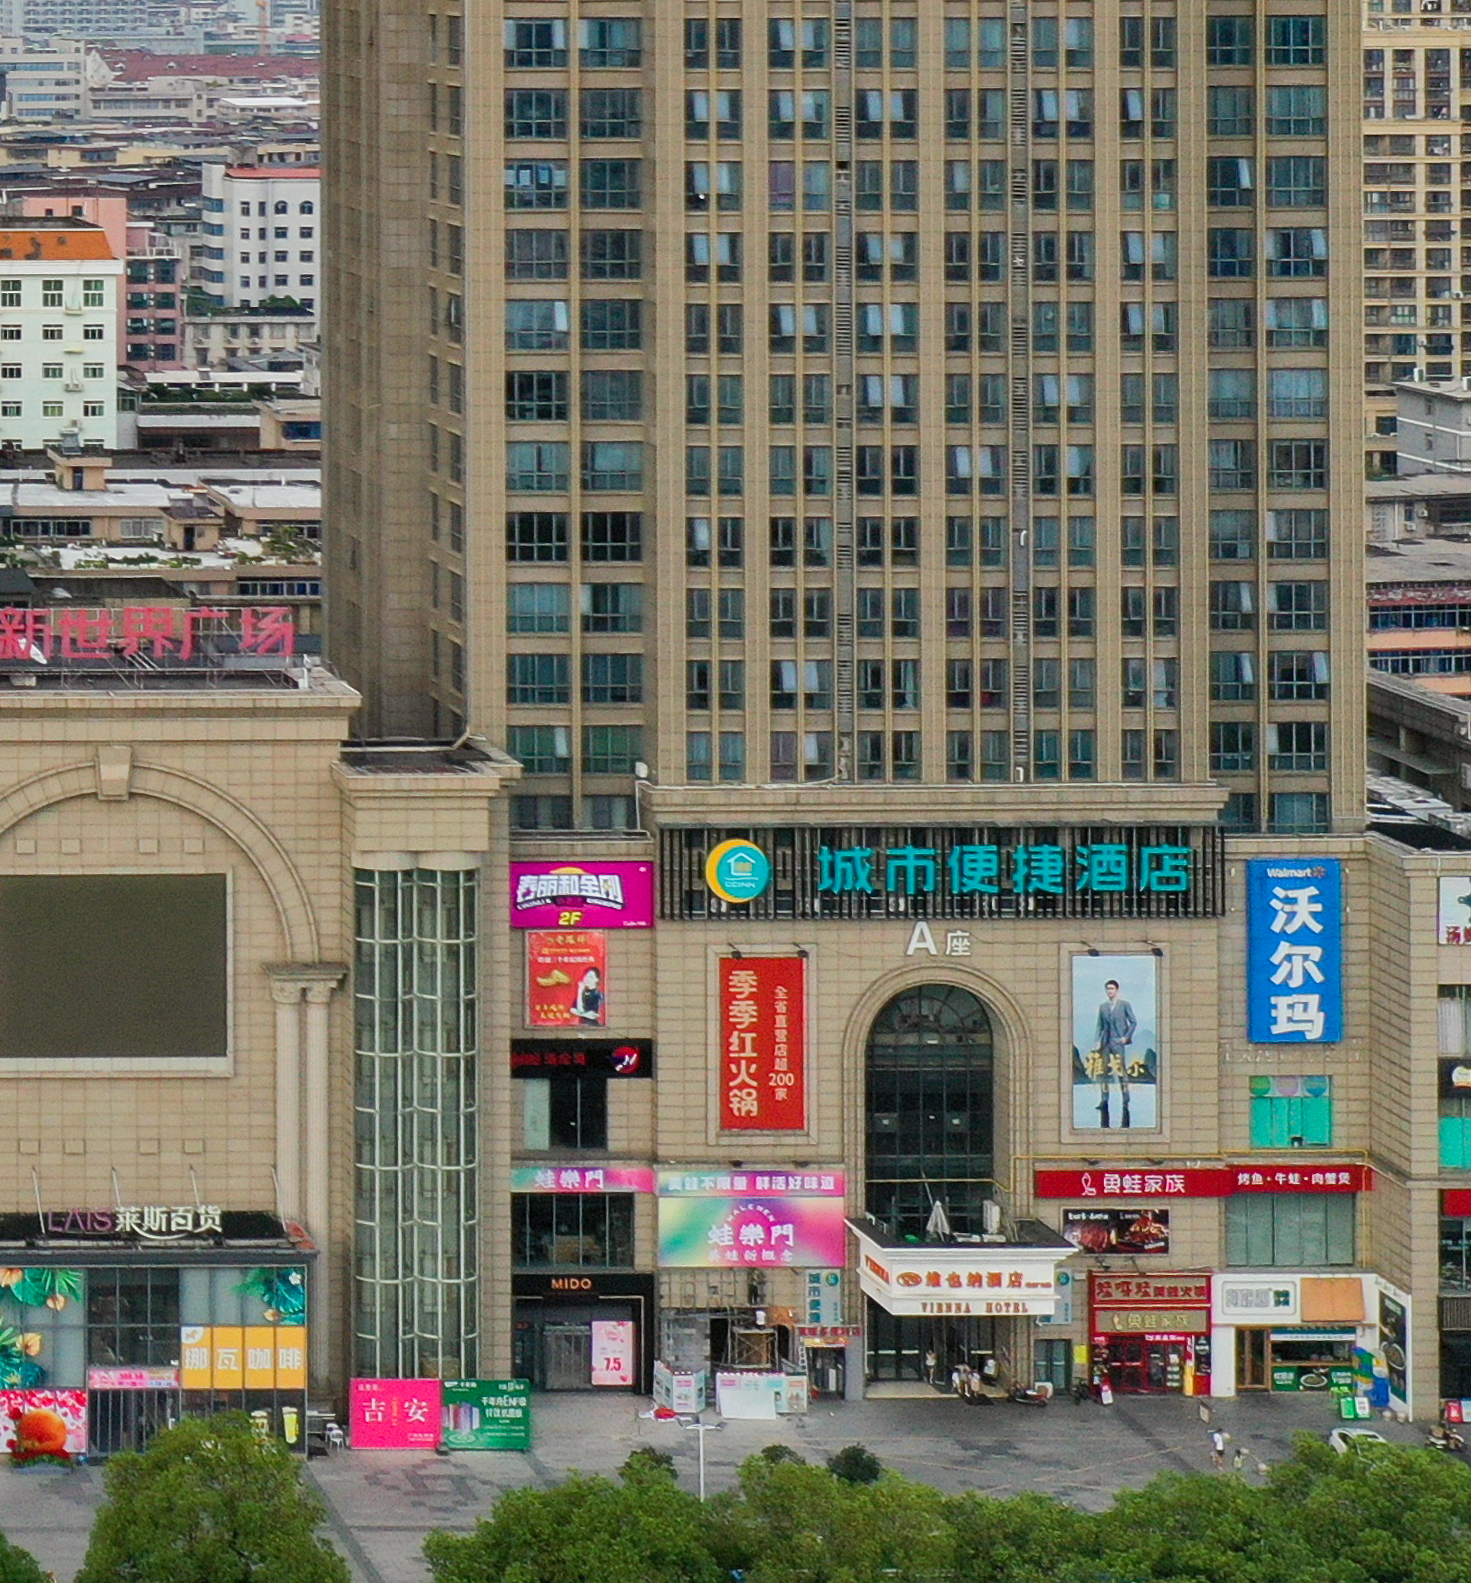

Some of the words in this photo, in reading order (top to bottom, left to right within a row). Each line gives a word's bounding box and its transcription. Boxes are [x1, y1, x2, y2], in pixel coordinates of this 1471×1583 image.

[818, 844, 1191, 894] 城市便捷酒店
[1267, 867, 1312, 878] Walmart
[558, 911, 581, 925] 2F
[905, 921, 972, 957] A座
[1269, 885, 1326, 1040] 沃尔玛
[728, 970, 758, 1116] 季季红火锅
[114, 1205, 223, 1239] 莱斯百货
[551, 1277, 592, 1290] MIDO
[925, 1270, 1023, 1289] 维也纳酒店
[921, 1302, 971, 1314] VIENNA
[985, 1302, 1029, 1314] HOTEL
[184, 1347, 303, 1371] 挪瓦咖啡
[604, 1357, 622, 1371] 7.5
